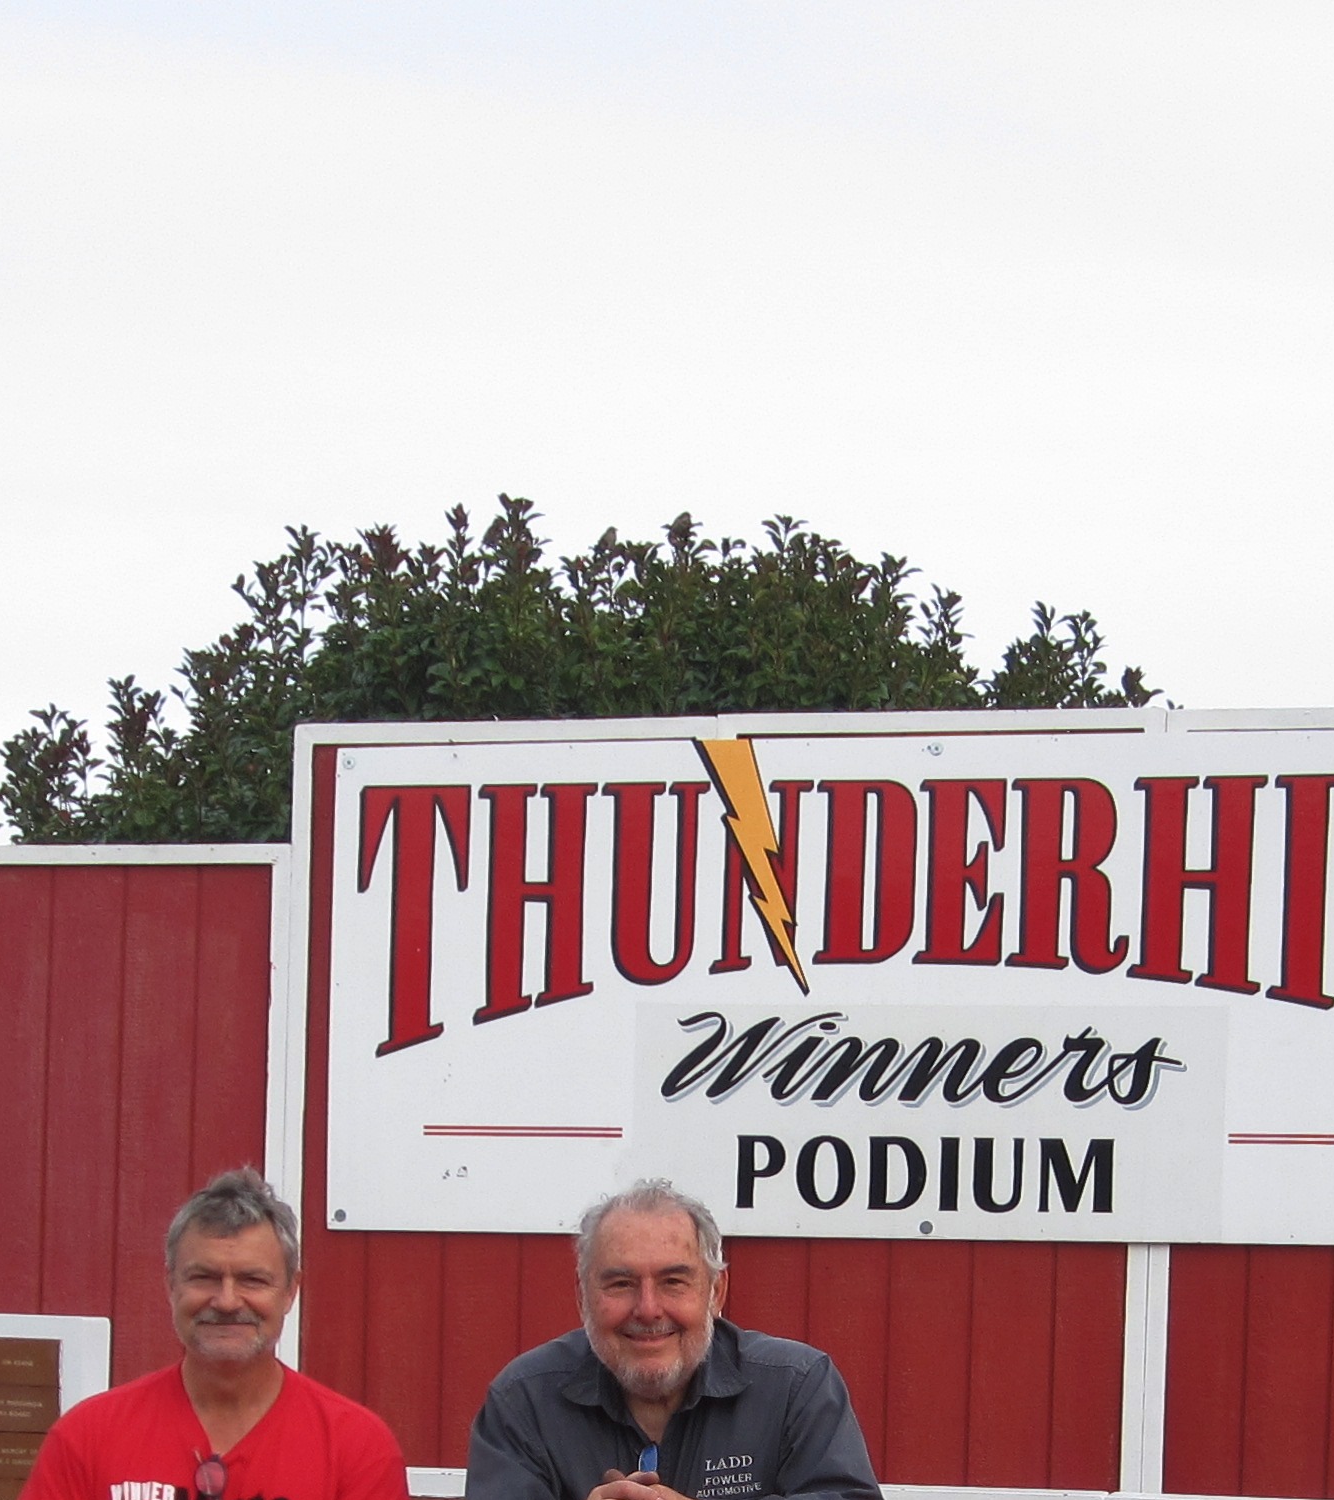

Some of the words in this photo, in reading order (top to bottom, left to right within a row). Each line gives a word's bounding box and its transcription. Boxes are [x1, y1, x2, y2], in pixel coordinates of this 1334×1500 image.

[662, 1011, 1180, 1109] Winners
[734, 1134, 1114, 1214] PODIUM
[705, 1455, 753, 1471] LADD
[704, 1473, 753, 1487] FOWLER
[696, 1482, 762, 1498] AUTOMOTIVE
